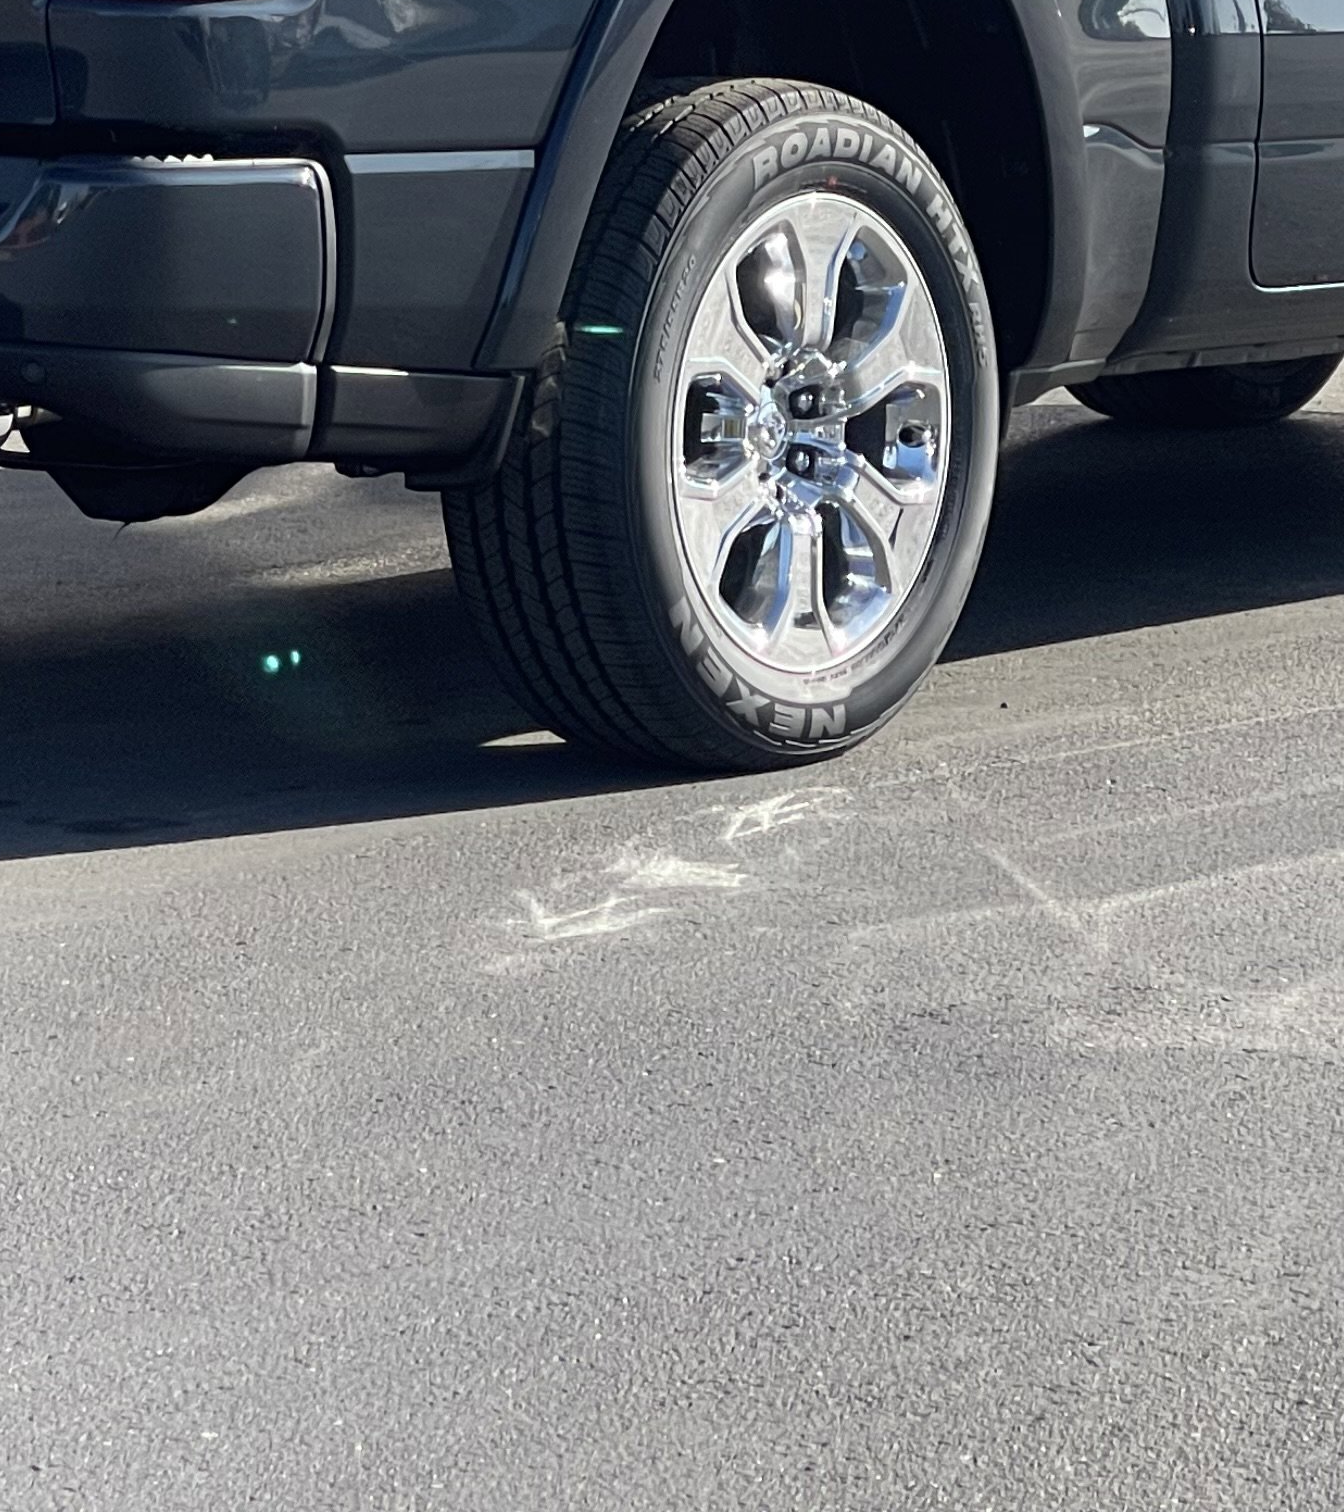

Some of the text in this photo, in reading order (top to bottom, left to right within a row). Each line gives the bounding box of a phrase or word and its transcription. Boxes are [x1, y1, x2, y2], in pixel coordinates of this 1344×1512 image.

[753, 127, 924, 194] ROADIAN
[925, 191, 980, 293] HTX
[668, 596, 848, 739] NEXEN
